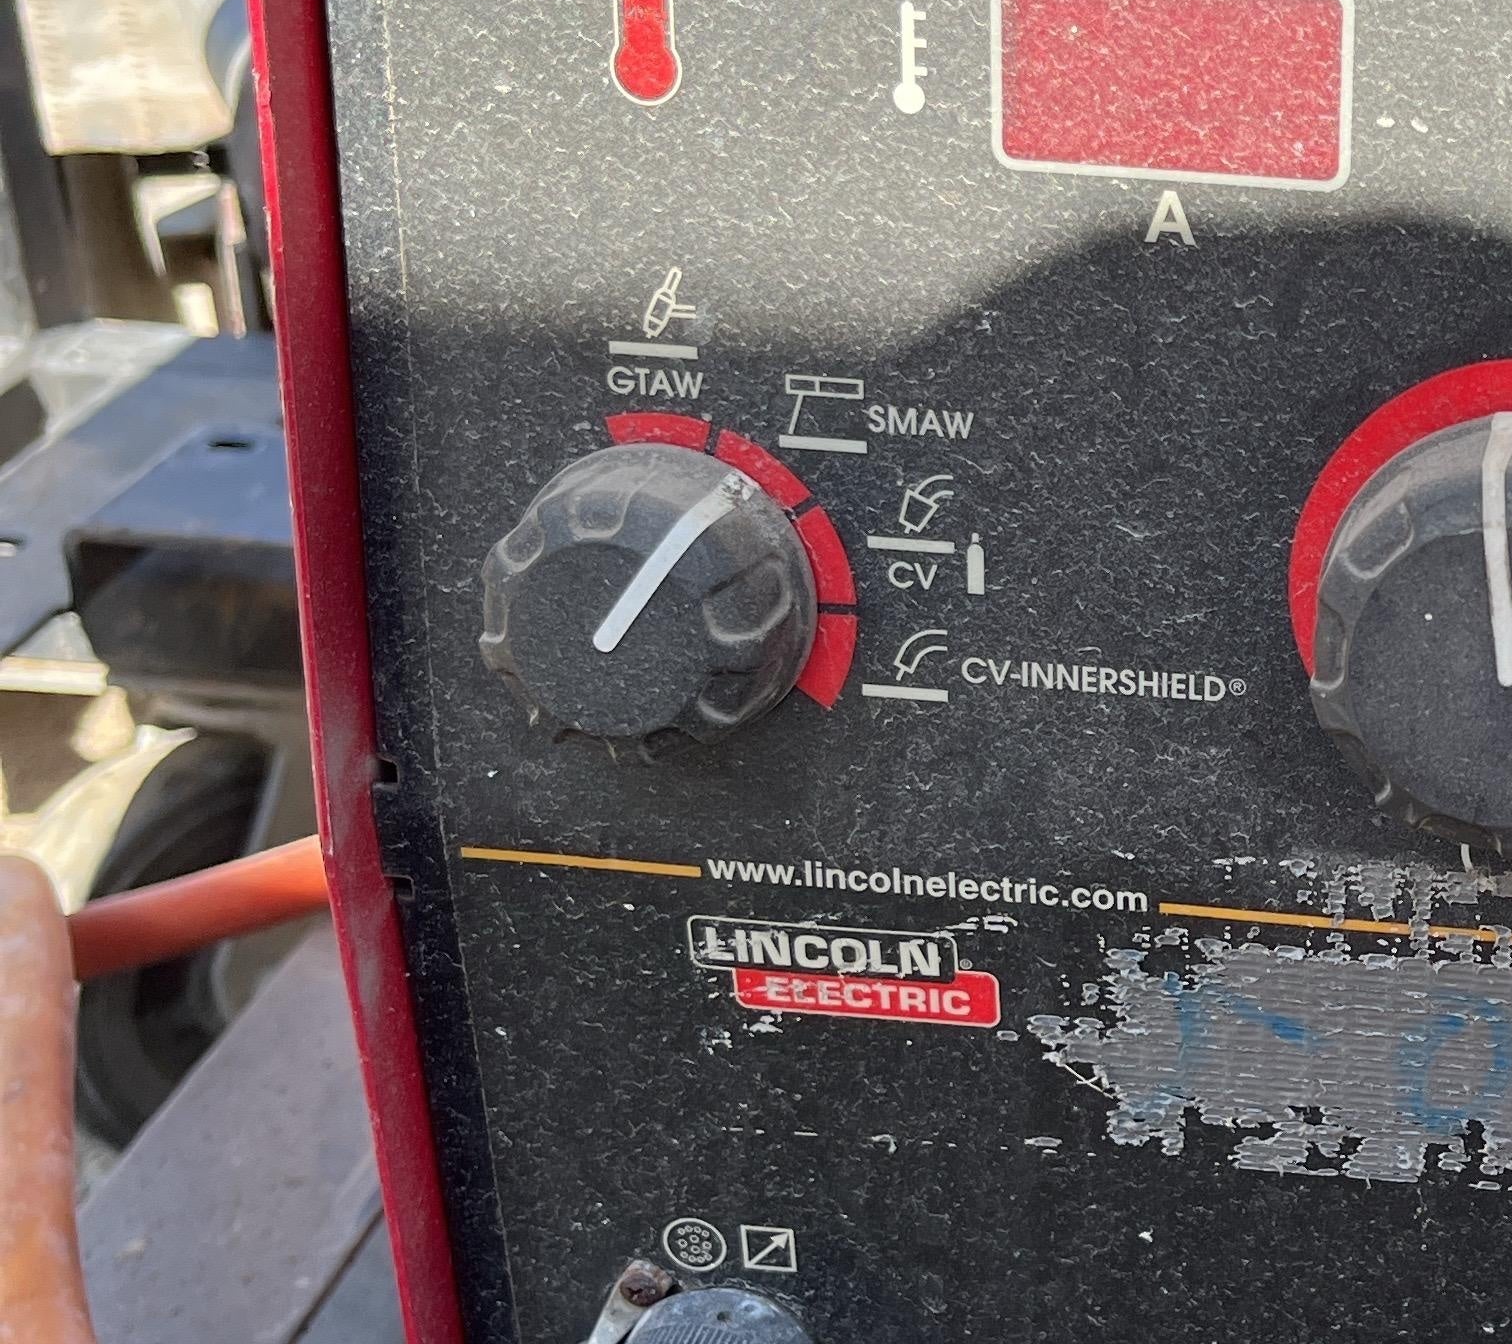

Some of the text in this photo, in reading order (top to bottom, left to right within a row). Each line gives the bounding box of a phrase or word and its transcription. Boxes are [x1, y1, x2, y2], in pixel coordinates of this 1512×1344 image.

[1143, 190, 1197, 248] A
[607, 366, 703, 400] GTAW
[867, 406, 974, 440] SMAW
[888, 562, 938, 591] CV
[707, 859, 1148, 913] www.lincolnelectric.com
[704, 927, 940, 977] LINCOLN
[765, 976, 972, 1016] ELECTRIC
